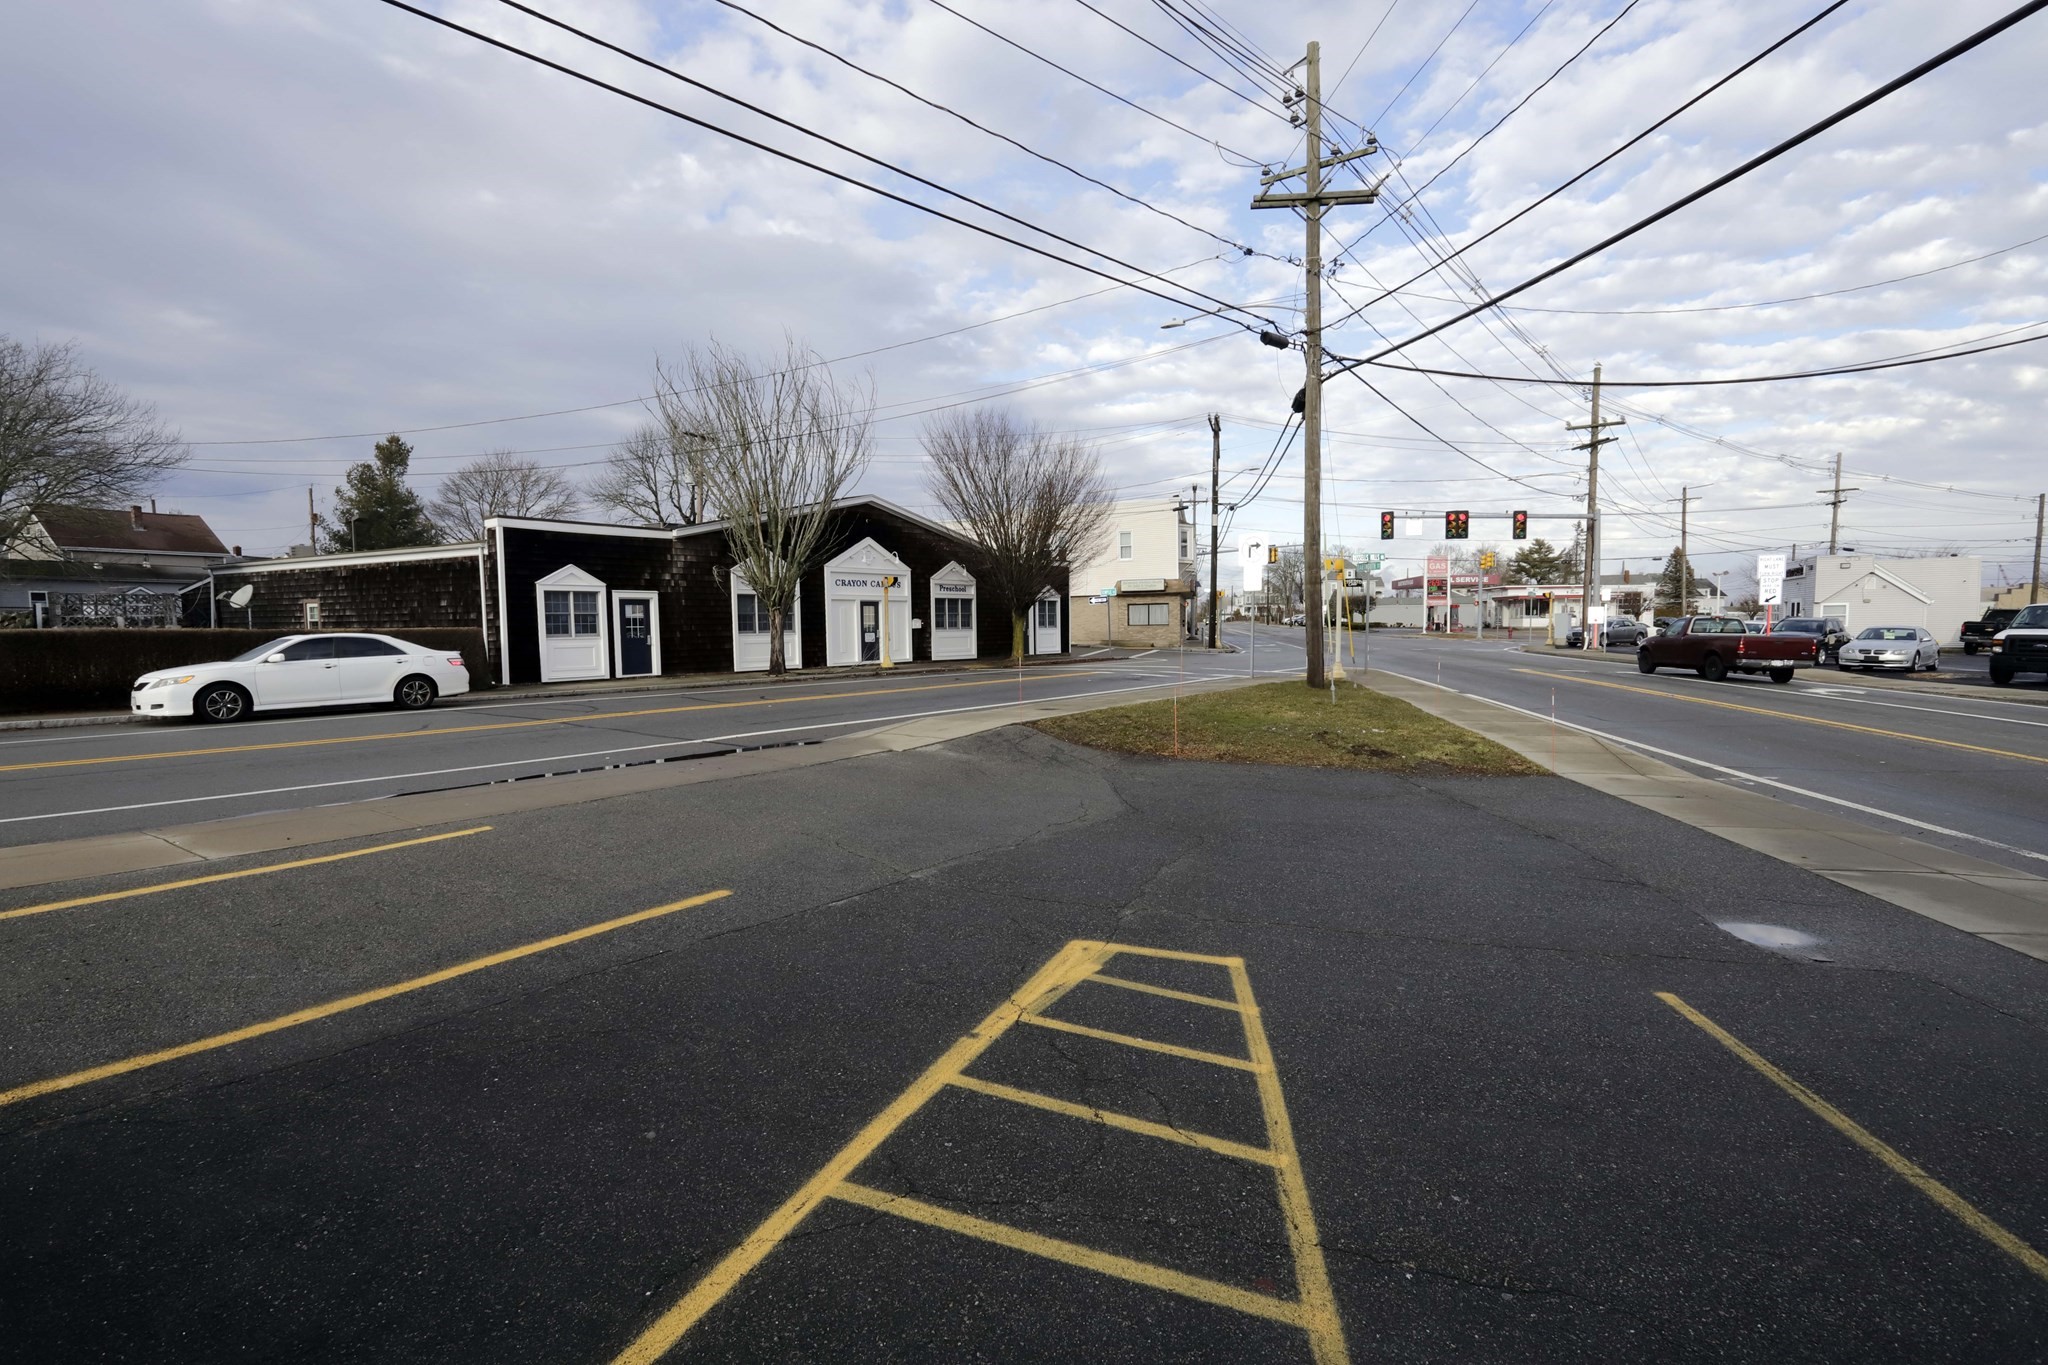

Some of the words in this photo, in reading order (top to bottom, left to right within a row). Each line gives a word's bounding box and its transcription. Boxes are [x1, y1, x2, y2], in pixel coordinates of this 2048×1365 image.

[1429, 562, 1446, 570] GAS
[835, 579, 868, 587] CRAYON
[870, 580, 901, 588] CAS
